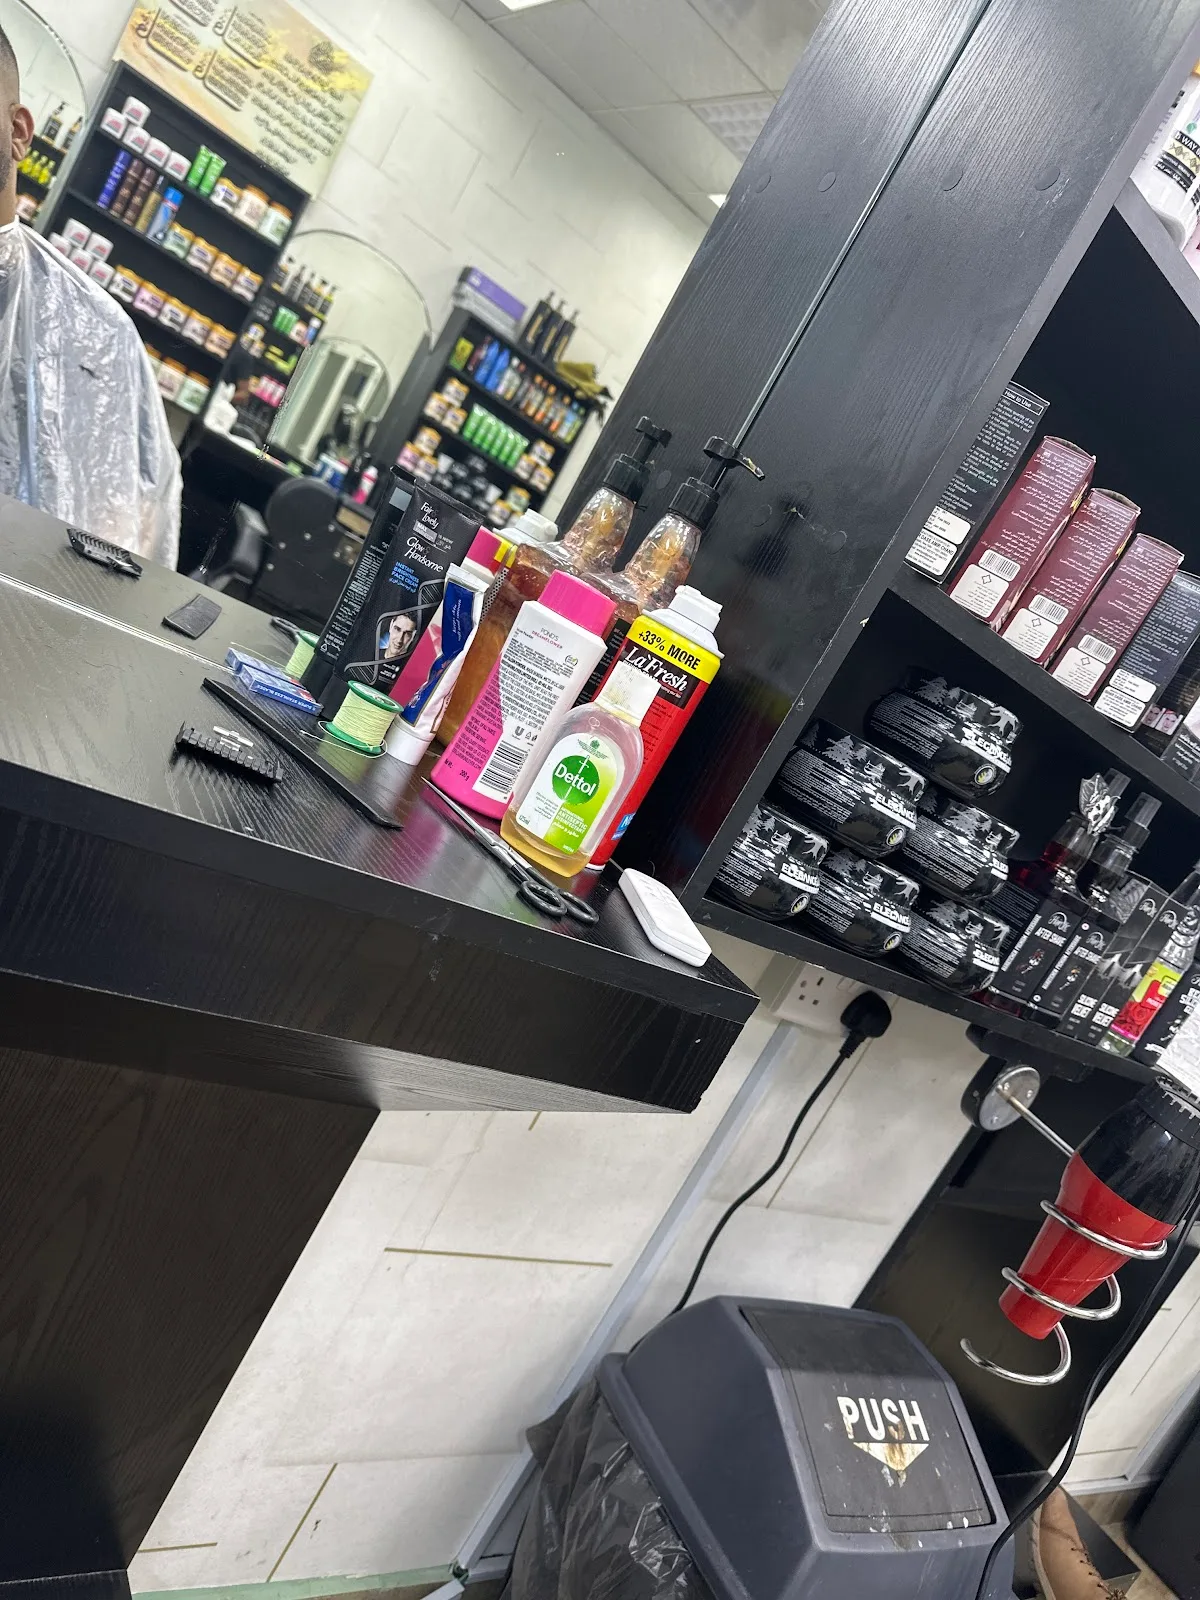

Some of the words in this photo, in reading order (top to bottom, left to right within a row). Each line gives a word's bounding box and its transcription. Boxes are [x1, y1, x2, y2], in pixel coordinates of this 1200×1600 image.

[1180, 135, 1197, 150] WAY
[1004, 390, 1016, 399] How
[1020, 399, 1031, 407] Use
[420, 501, 435, 515] Fair
[420, 512, 440, 530] Lovely
[405, 534, 426, 552] Glow
[395, 561, 414, 574] INSTANT
[404, 546, 444, 575] Handsome
[390, 570, 405, 581] FACE
[403, 577, 418, 588] CREAM
[531, 630, 563, 650] DREAMFLOWER
[637, 627, 668, 652] +33%
[666, 643, 701, 670] MORE
[256, 684, 274, 694] BLADES
[274, 691, 297, 703] STAINLESS
[297, 700, 312, 709] SUPER
[553, 763, 597, 796] Dettol
[557, 810, 587, 830] ANTISEPTIC
[1034, 924, 1052, 941] AFTER
[1048, 932, 1066, 948] SHAVE
[837, 1396, 930, 1441] PUSH
